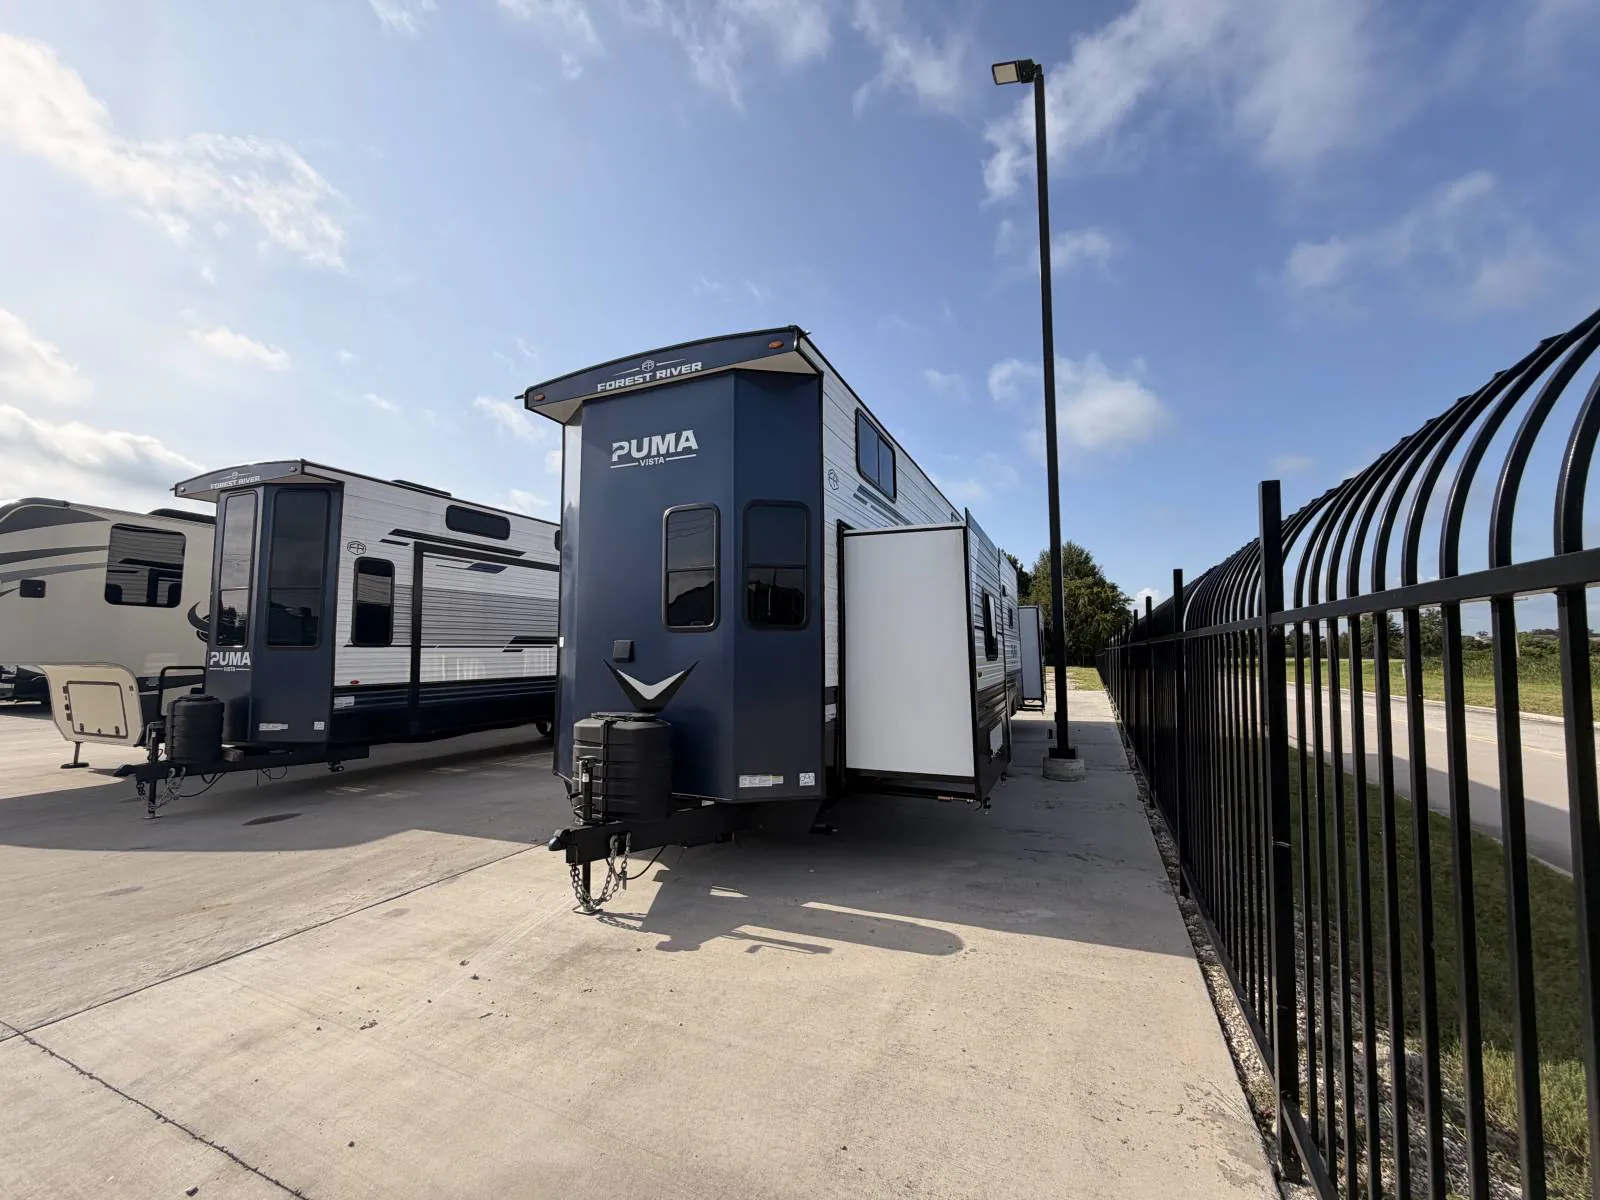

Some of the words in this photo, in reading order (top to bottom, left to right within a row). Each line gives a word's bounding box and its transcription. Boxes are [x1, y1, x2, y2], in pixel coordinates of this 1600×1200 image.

[597, 373, 653, 392] FOREST
[656, 362, 702, 380] RIVER
[611, 430, 699, 462] PUMA
[640, 456, 665, 467] VISTA
[209, 651, 251, 665] PUMA
